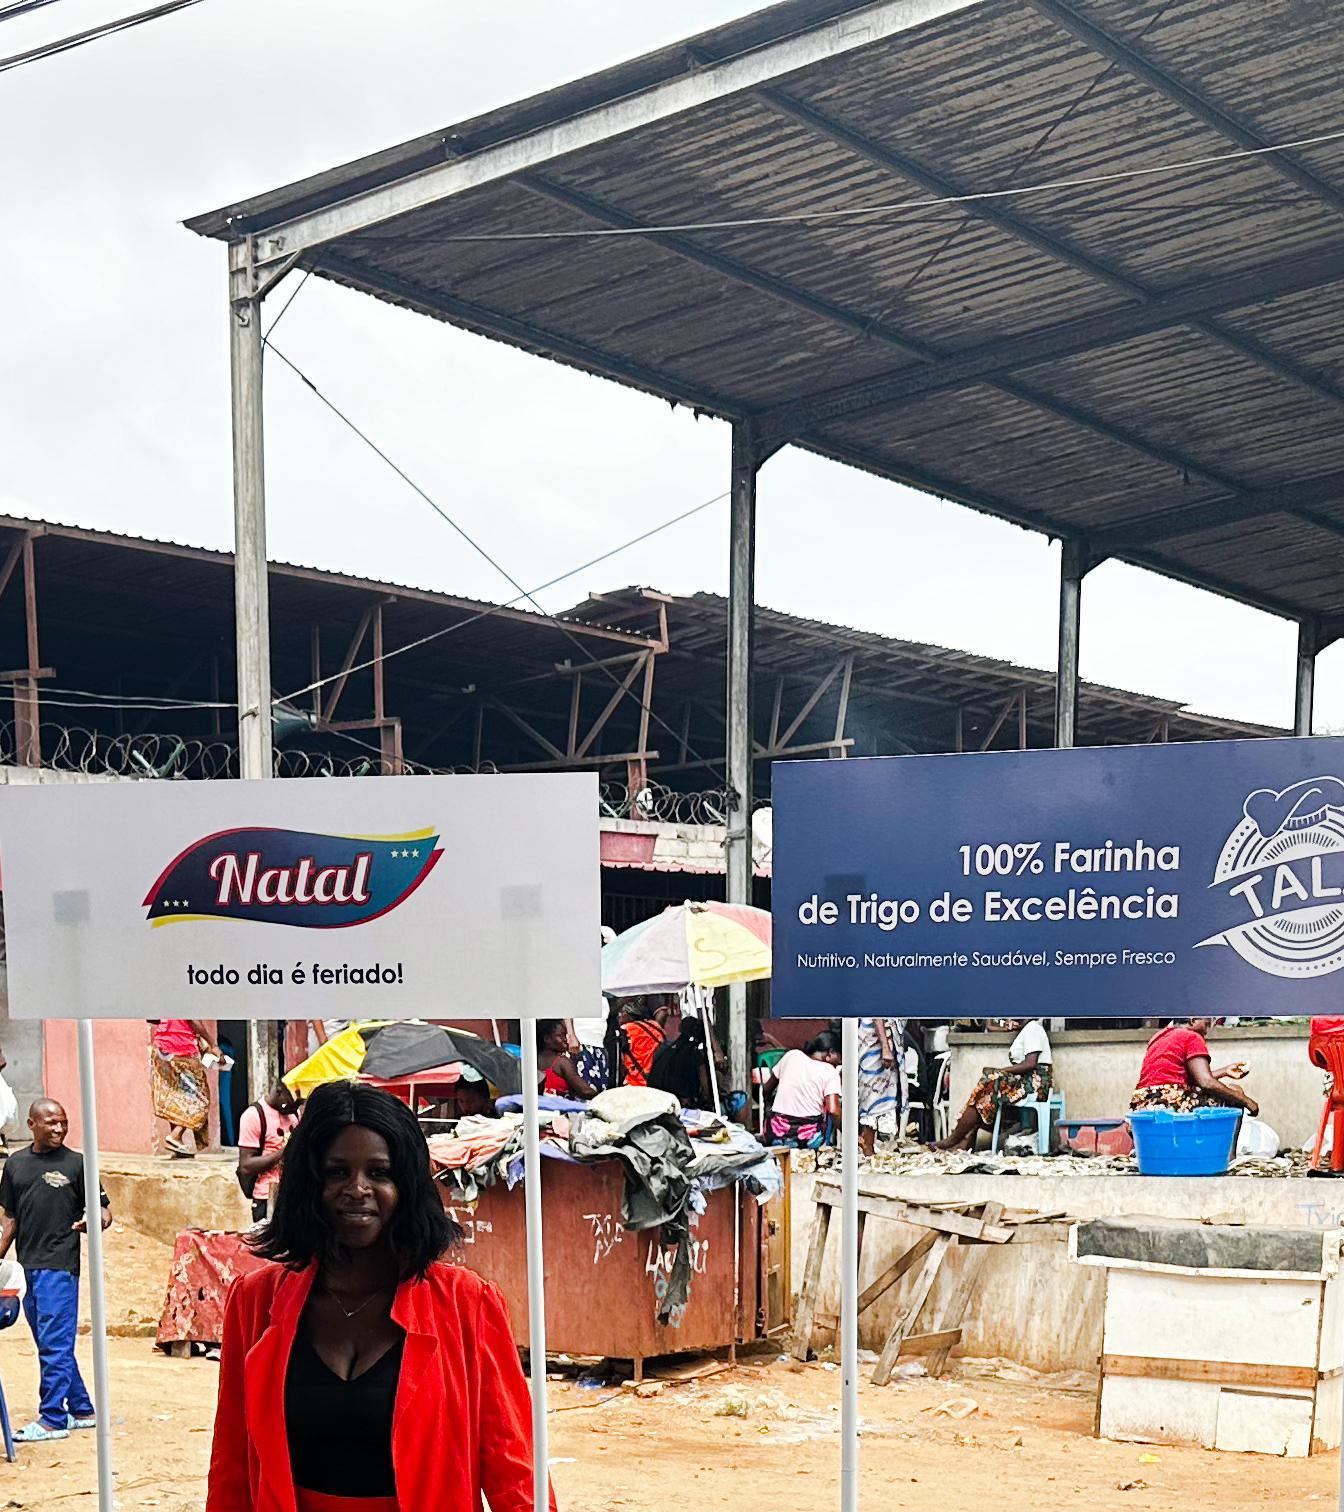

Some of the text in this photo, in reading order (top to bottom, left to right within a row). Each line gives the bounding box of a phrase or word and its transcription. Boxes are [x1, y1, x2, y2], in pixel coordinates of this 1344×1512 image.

[958, 840, 1180, 877] 100% Farinha
[210, 851, 374, 905] Natal
[798, 888, 1179, 931] de Trigo de Excelência
[188, 962, 403, 986] todo dia é feriado!
[797, 947, 1176, 971] Nutritivo, Naturalmente Saudável, Sempre Fresco
